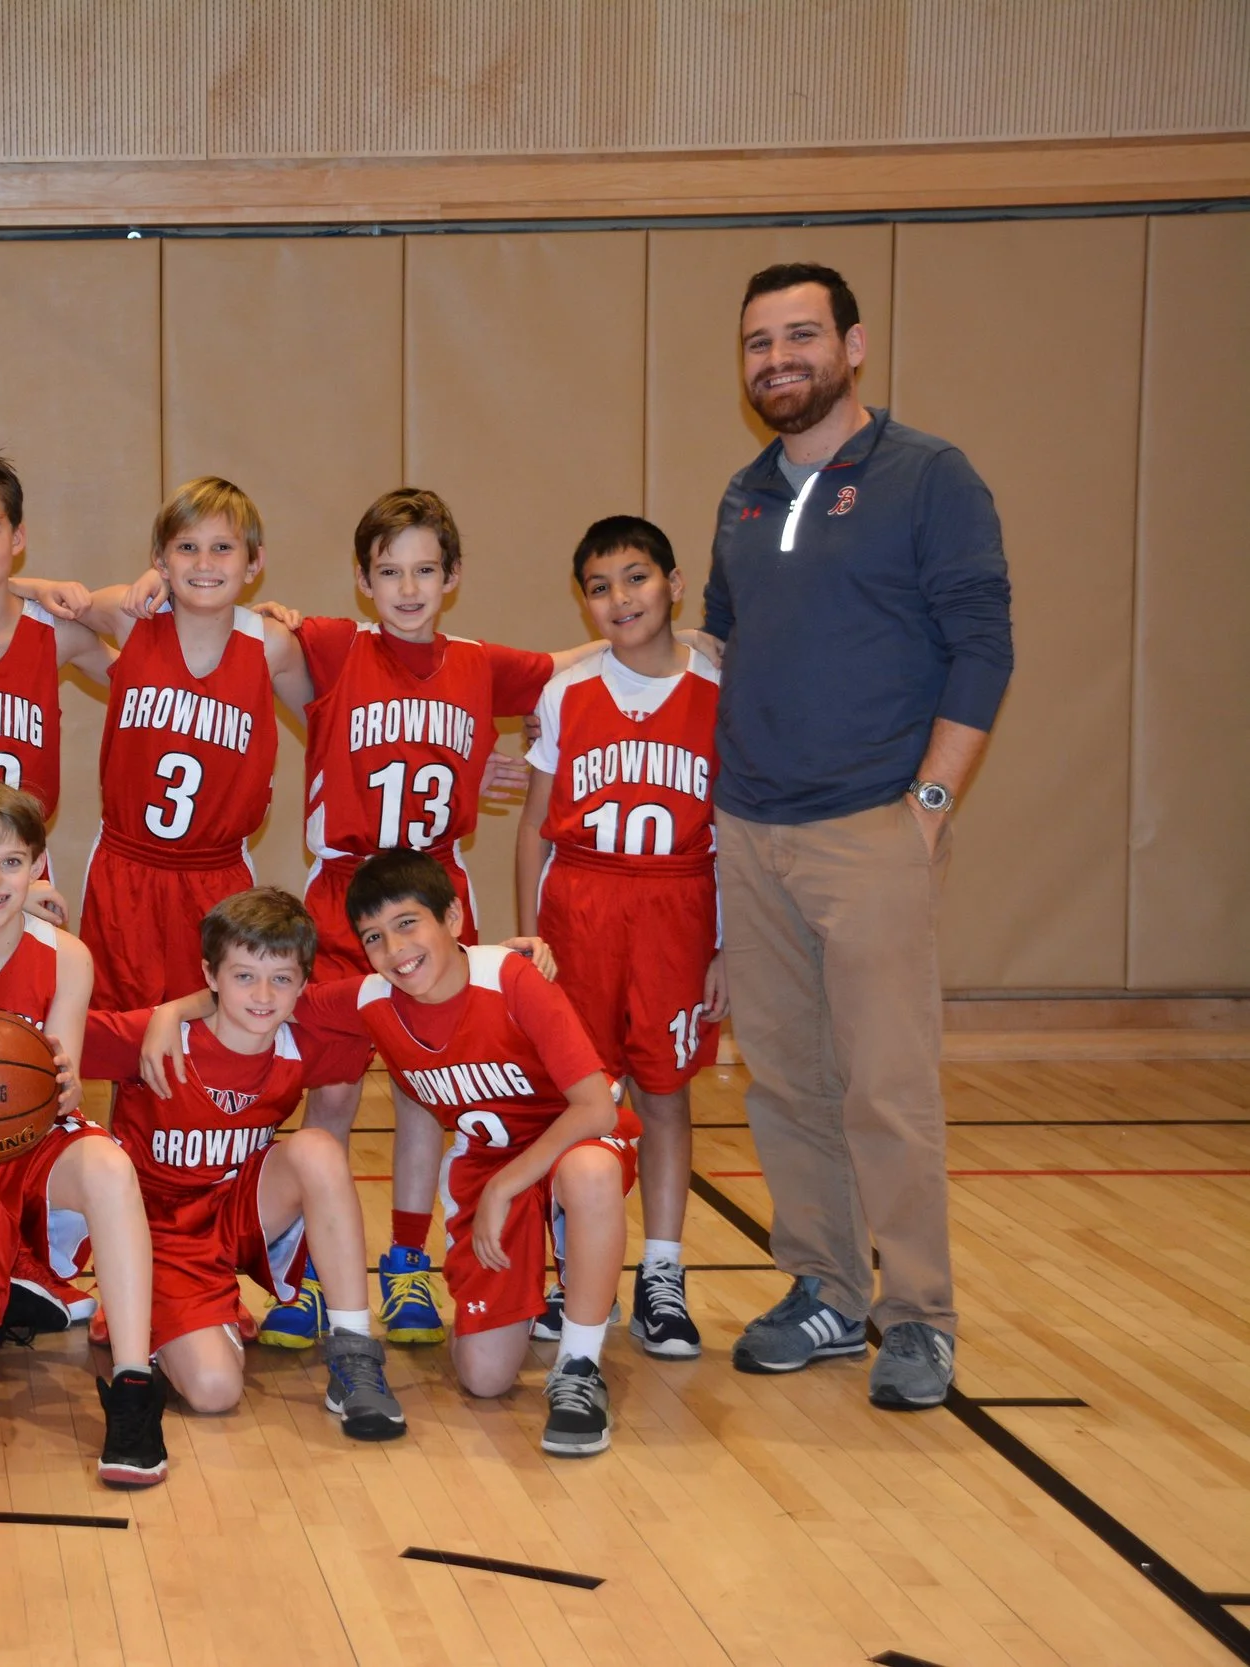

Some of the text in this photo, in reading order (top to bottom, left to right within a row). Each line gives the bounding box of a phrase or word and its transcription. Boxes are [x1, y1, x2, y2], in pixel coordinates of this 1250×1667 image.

[118, 685, 254, 755] BROWNING
[349, 697, 476, 762] BROWNING
[144, 751, 203, 841] 3
[572, 739, 711, 803] BROWNING
[368, 760, 455, 851] 13
[582, 800, 675, 856] 10
